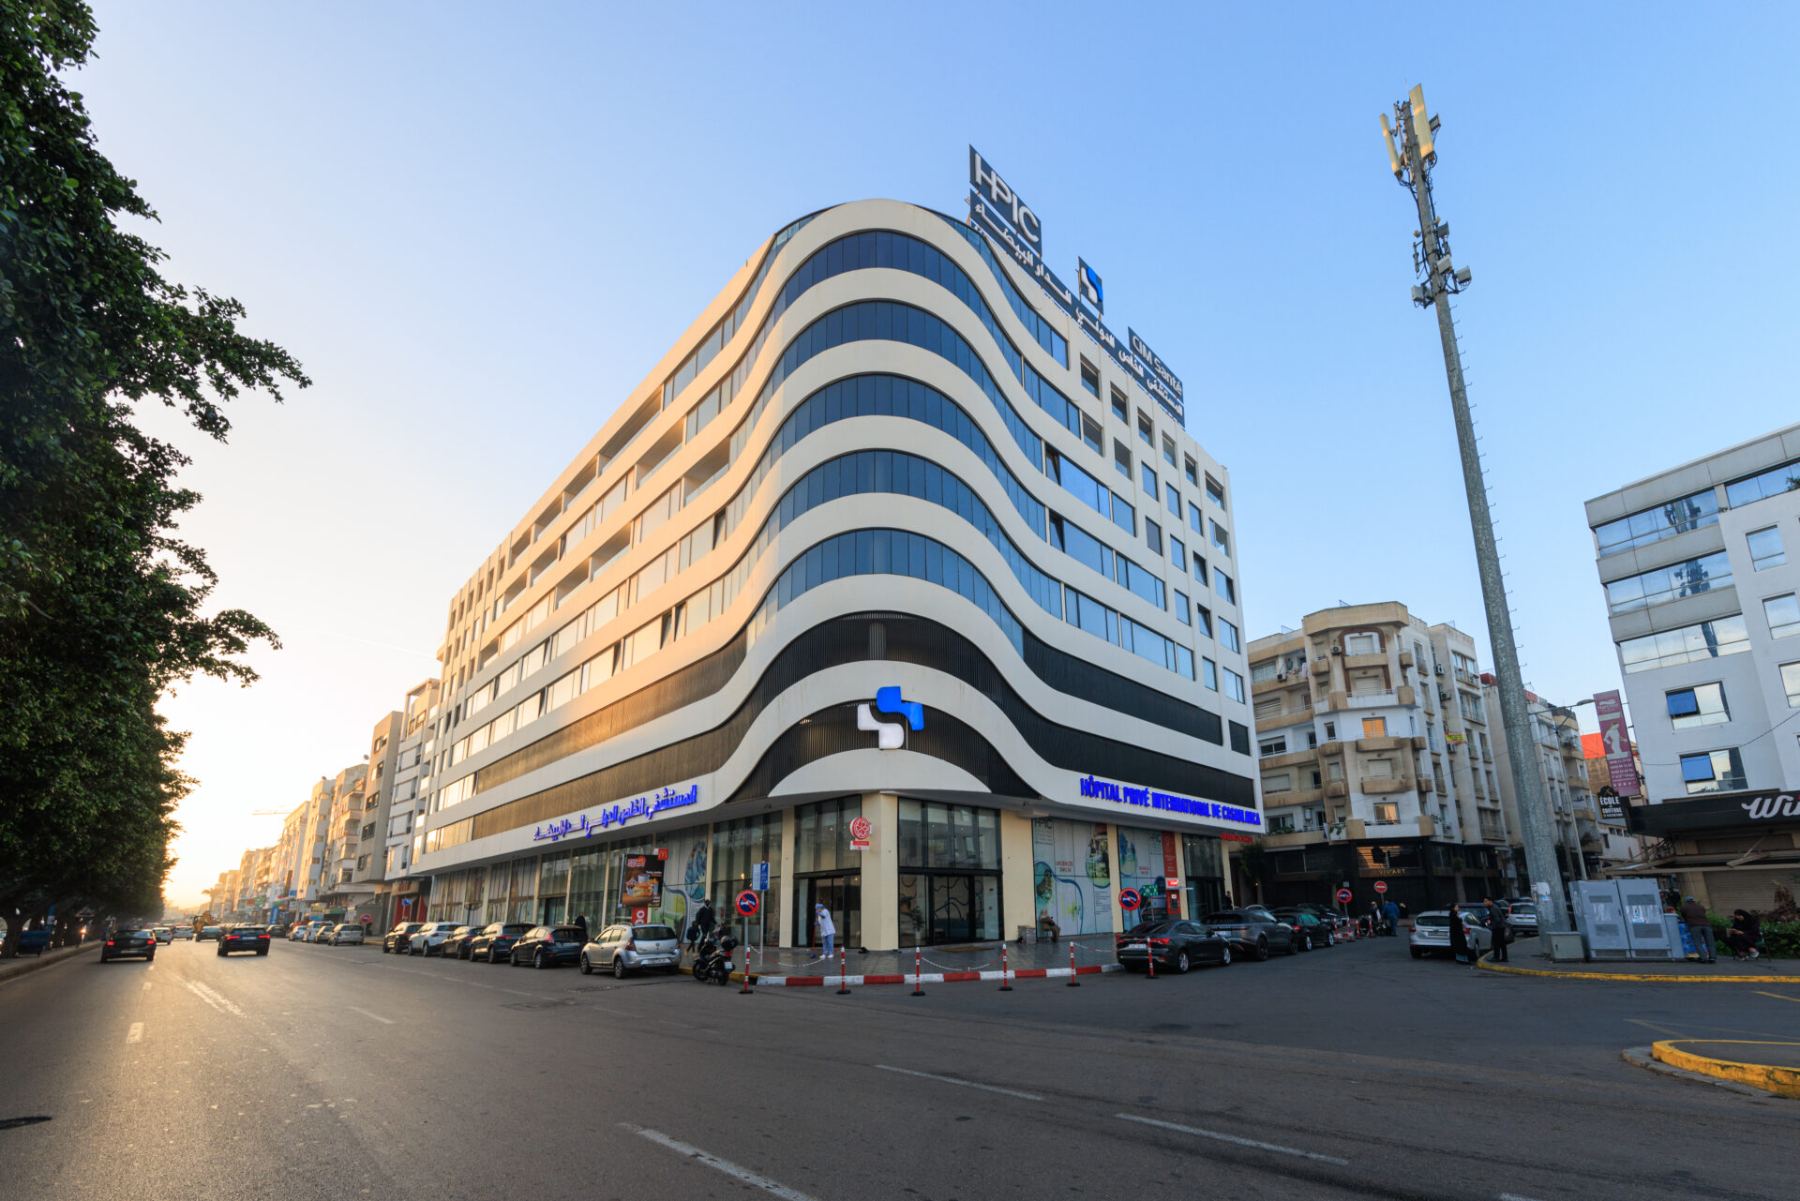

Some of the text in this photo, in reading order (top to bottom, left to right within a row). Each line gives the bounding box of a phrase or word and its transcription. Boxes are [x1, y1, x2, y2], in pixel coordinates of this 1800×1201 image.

[975, 153, 1039, 242] HPIC
[618, 796, 647, 826] الخاص
[645, 784, 698, 821] المستشفى
[1079, 775, 1262, 826] HÔPITAL PRIVÉ INTERNATIONAL DE CASABLANCA
